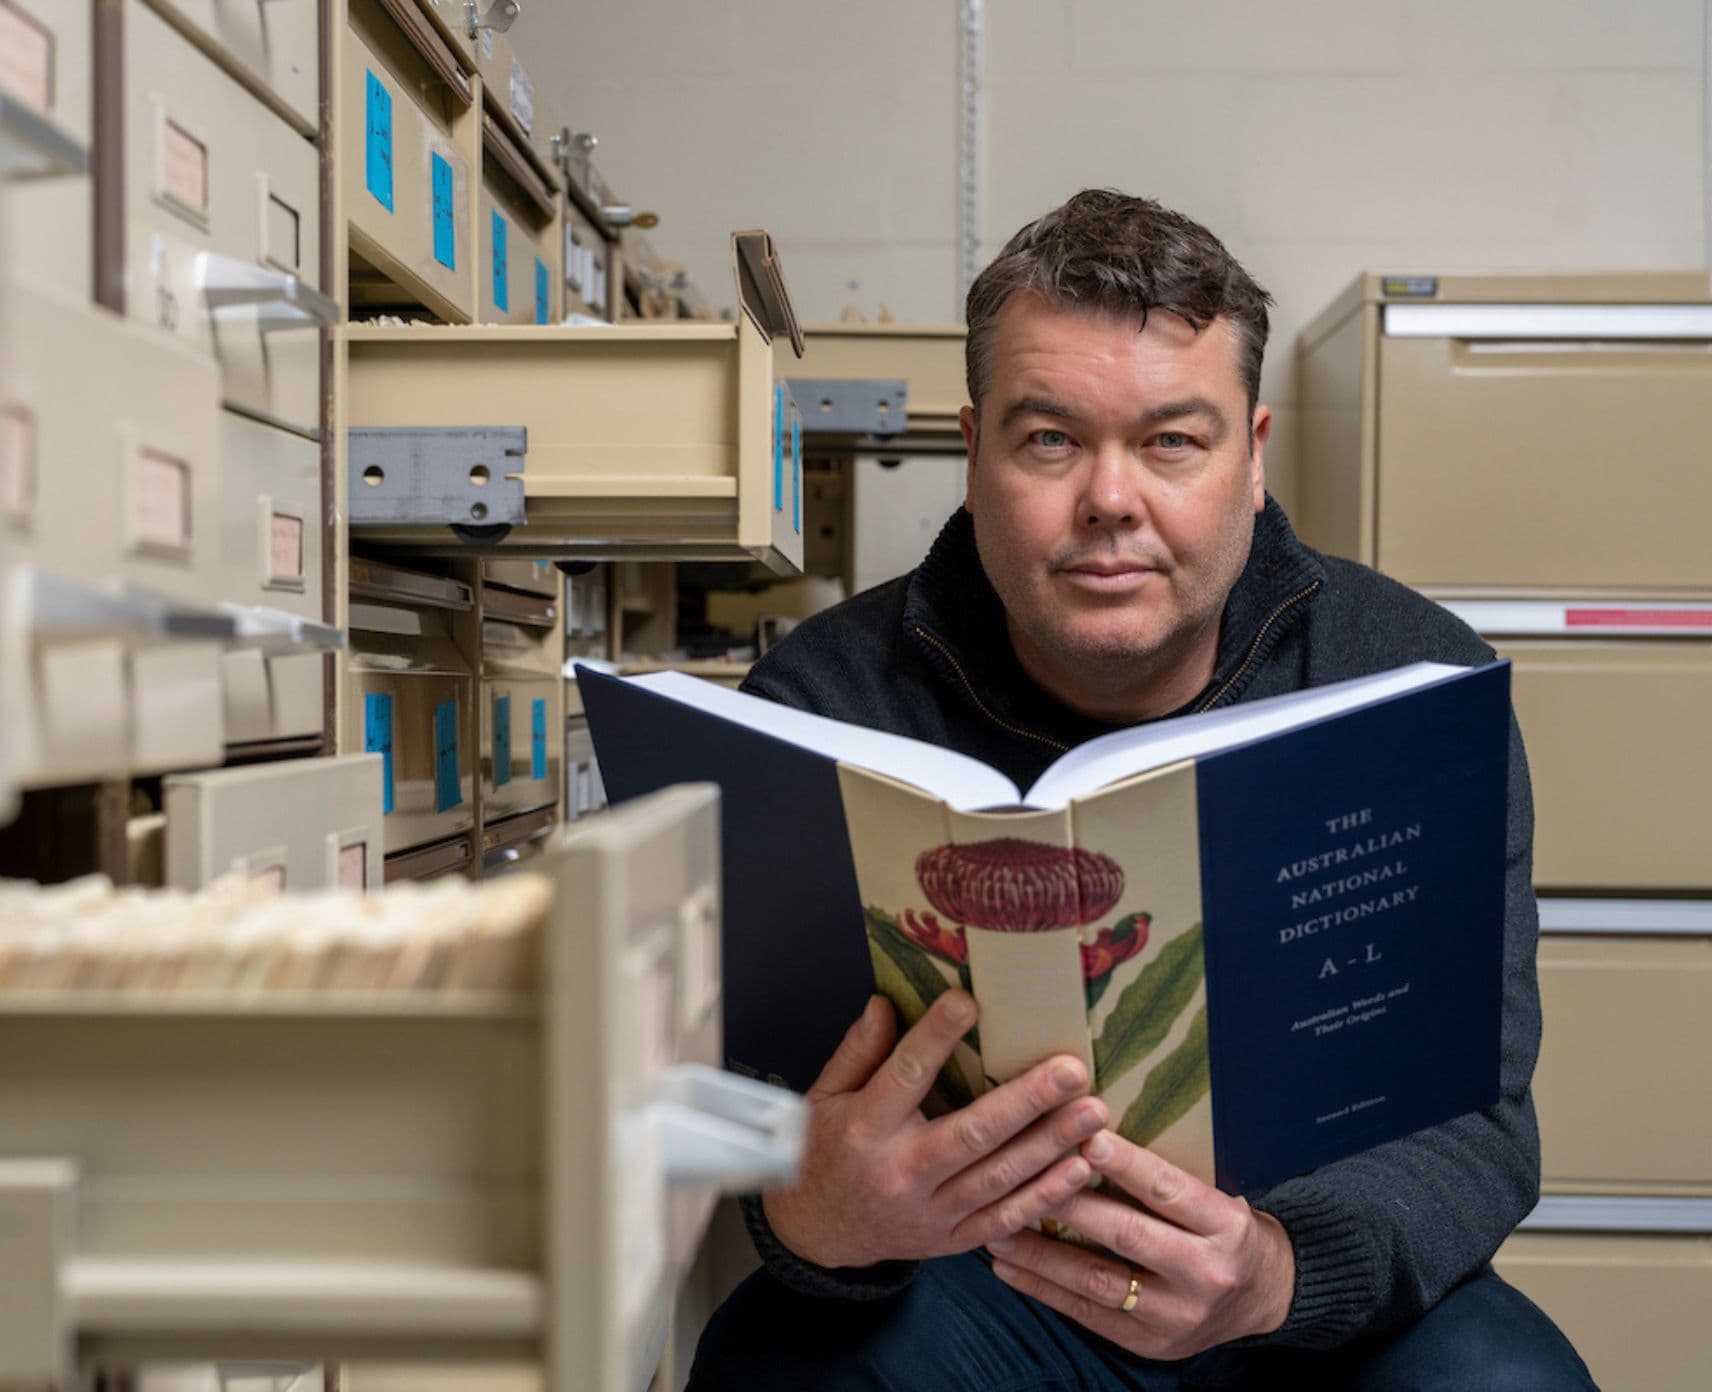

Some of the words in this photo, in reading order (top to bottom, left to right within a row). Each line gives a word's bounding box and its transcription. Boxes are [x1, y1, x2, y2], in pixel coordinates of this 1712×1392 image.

[1325, 808, 1372, 834] THE
[1276, 824, 1422, 883] AUSTRALIAN
[1291, 860, 1408, 909] NATIONAL
[1279, 886, 1420, 944] DICTIONARY
[1318, 958, 1339, 979] A
[1365, 943, 1383, 963] L
[1290, 1006, 1349, 1032] Australian
[1352, 992, 1386, 1010] Words
[1387, 983, 1410, 998] and
[1314, 1020, 1344, 1037] Their
